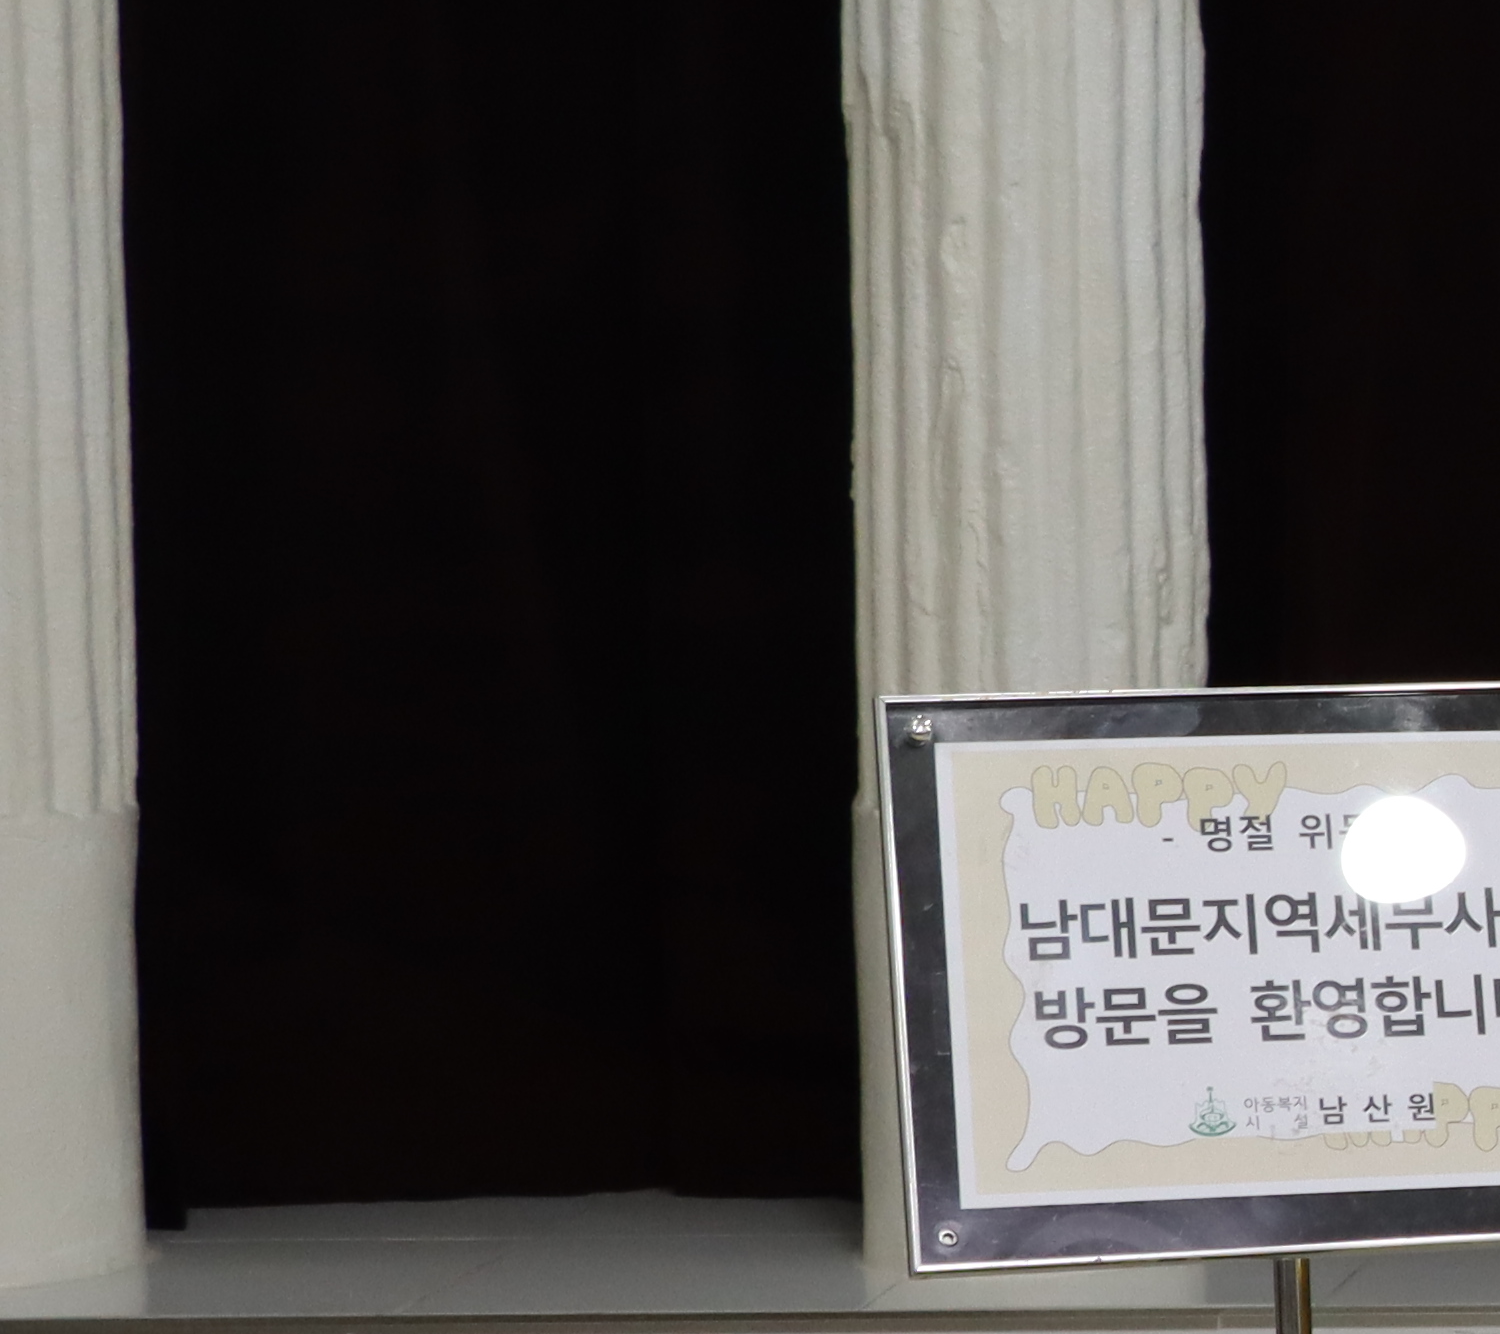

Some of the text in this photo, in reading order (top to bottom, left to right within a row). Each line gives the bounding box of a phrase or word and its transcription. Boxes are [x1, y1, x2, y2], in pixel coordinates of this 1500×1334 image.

[1031, 761, 1287, 832] HAPPY
[1200, 813, 1274, 853] 명절
[1299, 812, 1366, 851] 위
[1033, 983, 1219, 1050] 방문을
[1243, 1095, 1308, 1113] 아동복지
